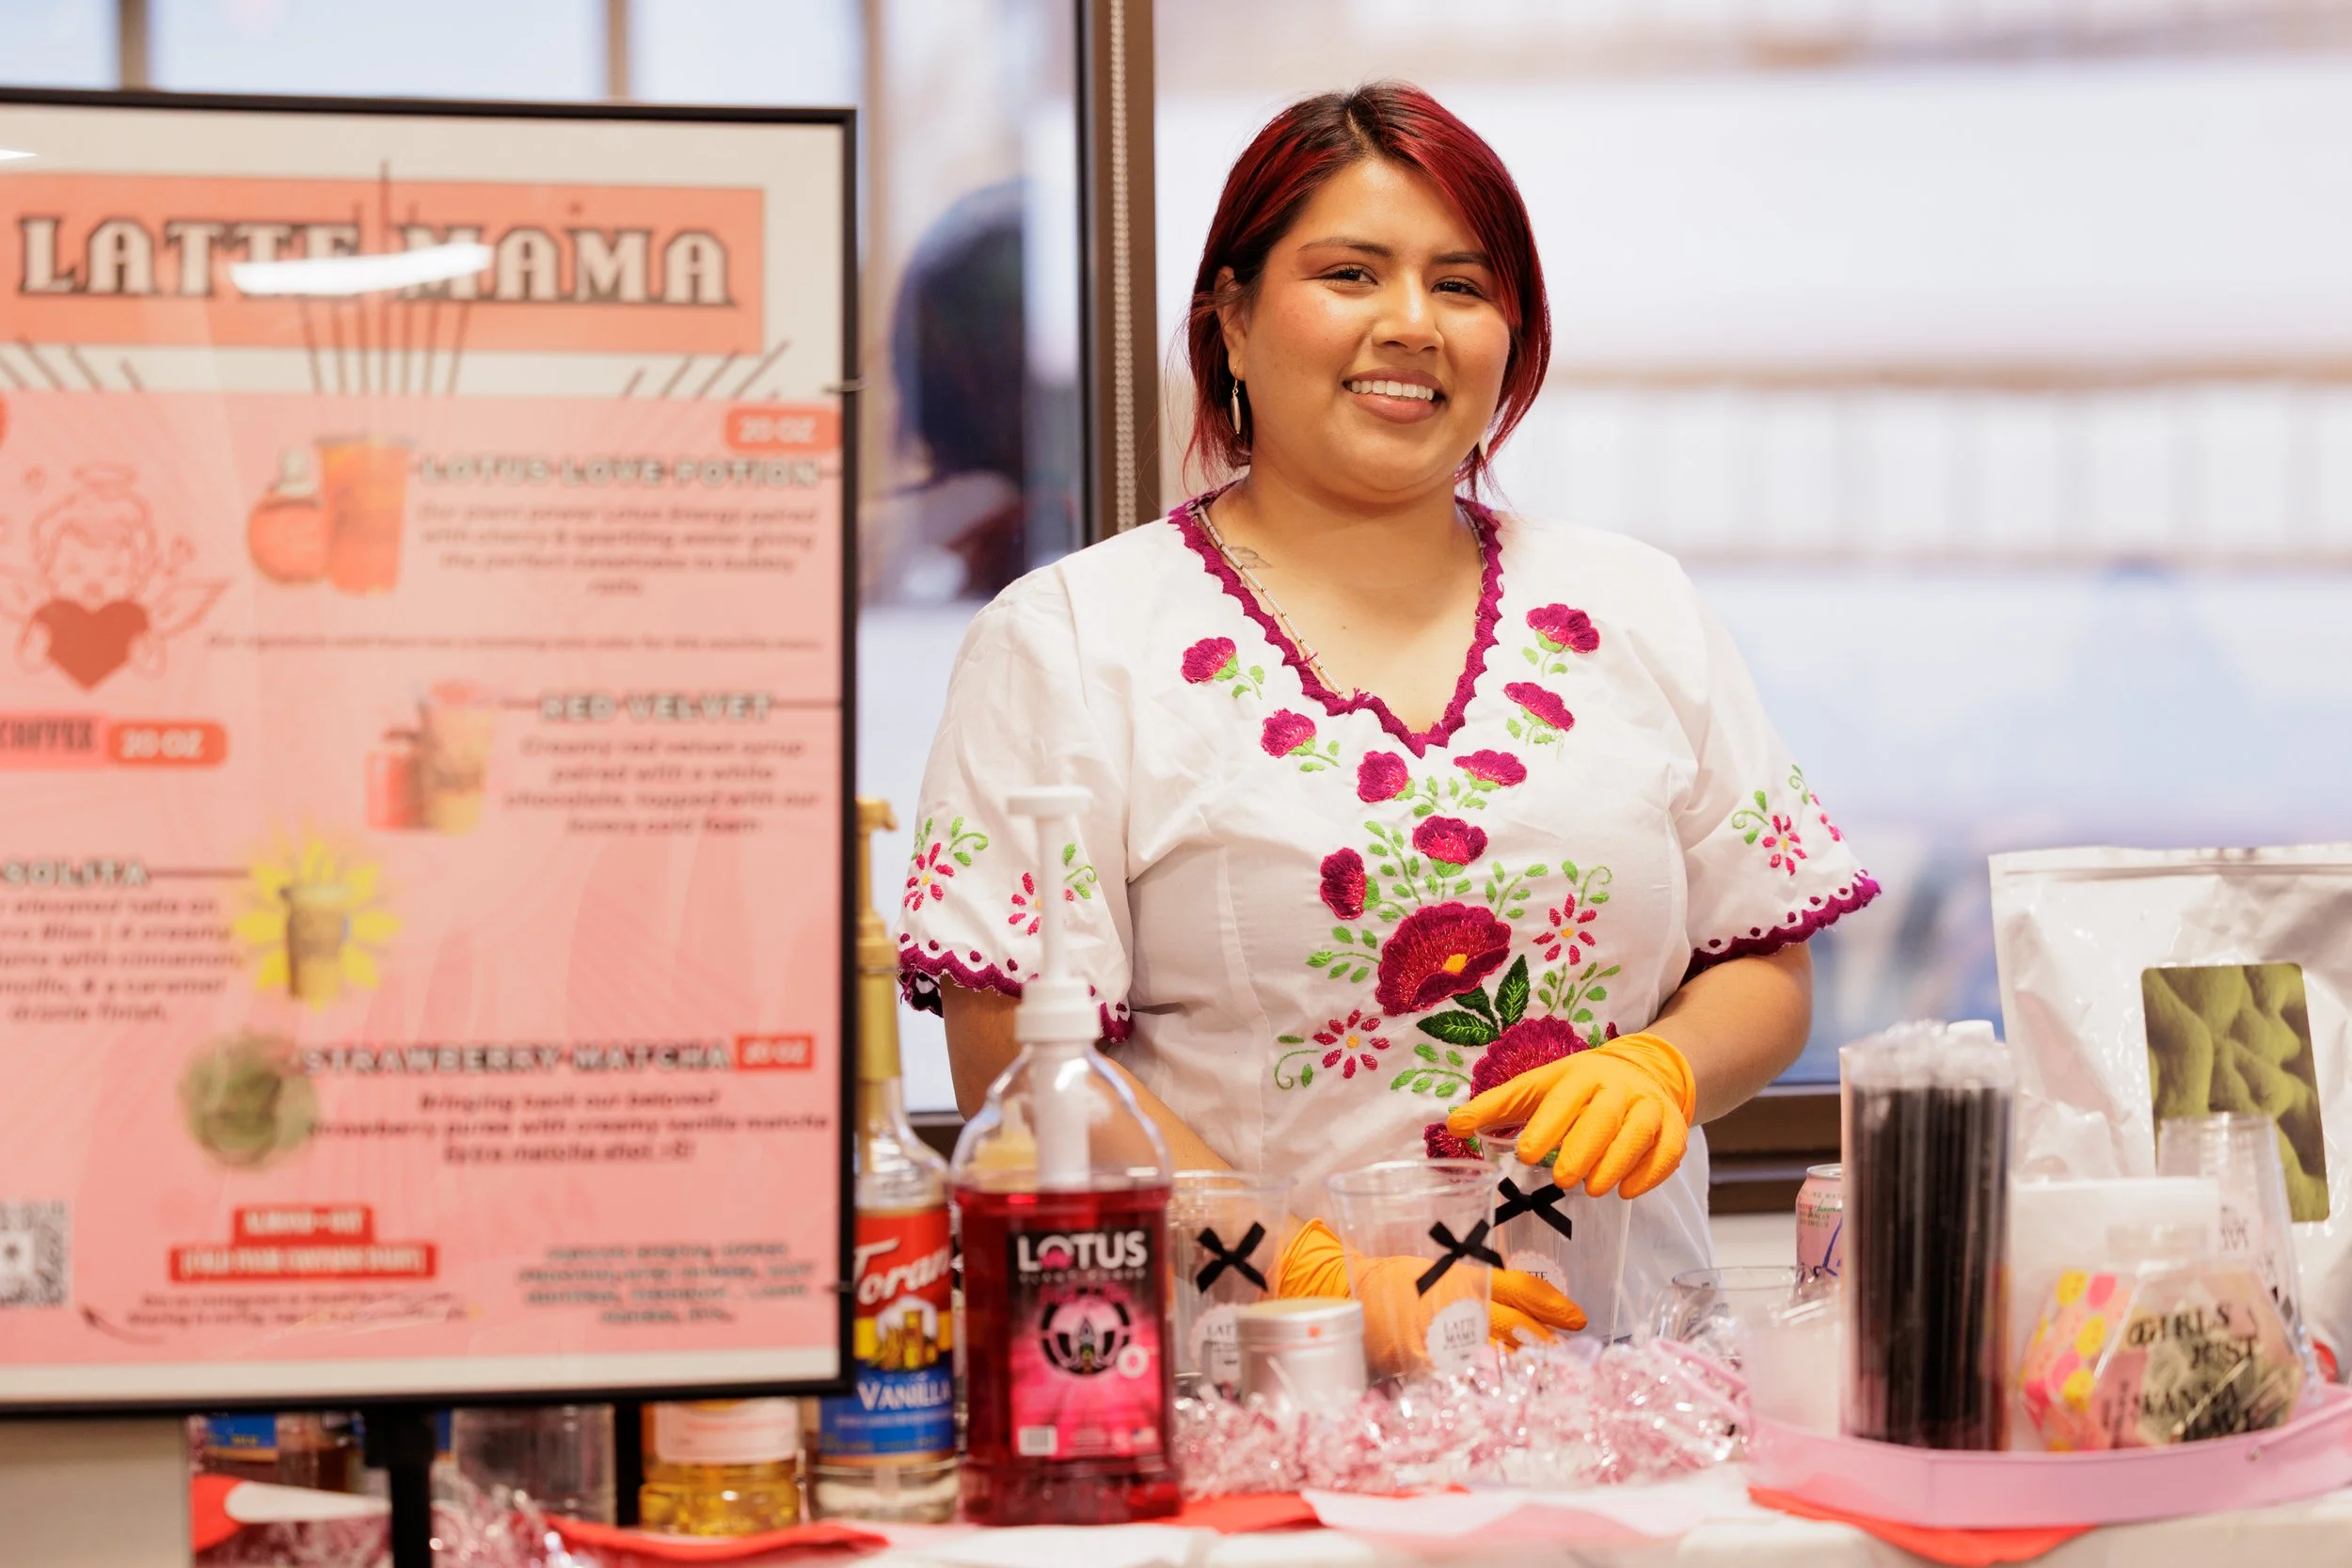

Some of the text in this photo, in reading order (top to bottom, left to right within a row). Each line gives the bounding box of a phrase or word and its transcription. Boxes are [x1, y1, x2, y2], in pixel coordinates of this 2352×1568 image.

[16, 215, 740, 308] LATTE MAMA
[421, 453, 821, 488] LOTUS LOVE POTION
[539, 693, 775, 722] RED VELVET
[302, 1044, 561, 1075] STRAWBERRY
[571, 1043, 731, 1072] MATCHA
[1016, 1228, 1150, 1272] LOTUS
[853, 1237, 953, 1306] Toran
[857, 1379, 952, 1411] VANILLA
